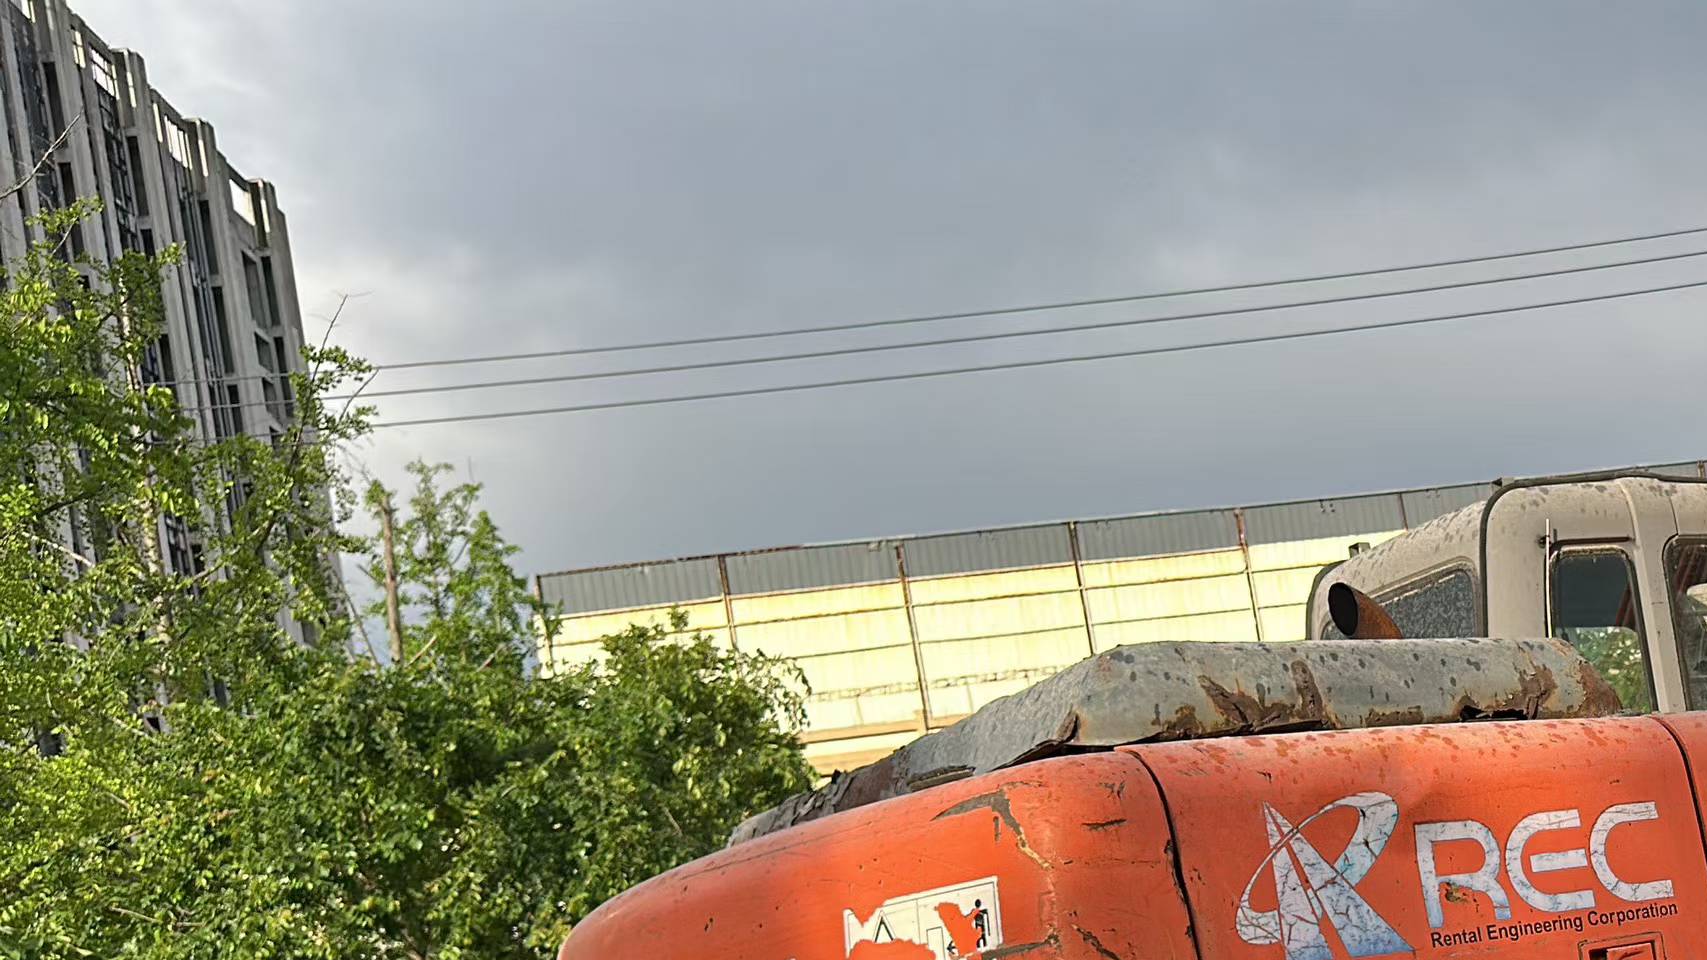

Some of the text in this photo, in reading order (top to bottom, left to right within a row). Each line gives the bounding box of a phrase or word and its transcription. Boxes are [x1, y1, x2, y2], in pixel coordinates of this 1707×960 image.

[1413, 800, 1675, 929] REC
[1430, 902, 1679, 949] Rental Engineering Corporation
